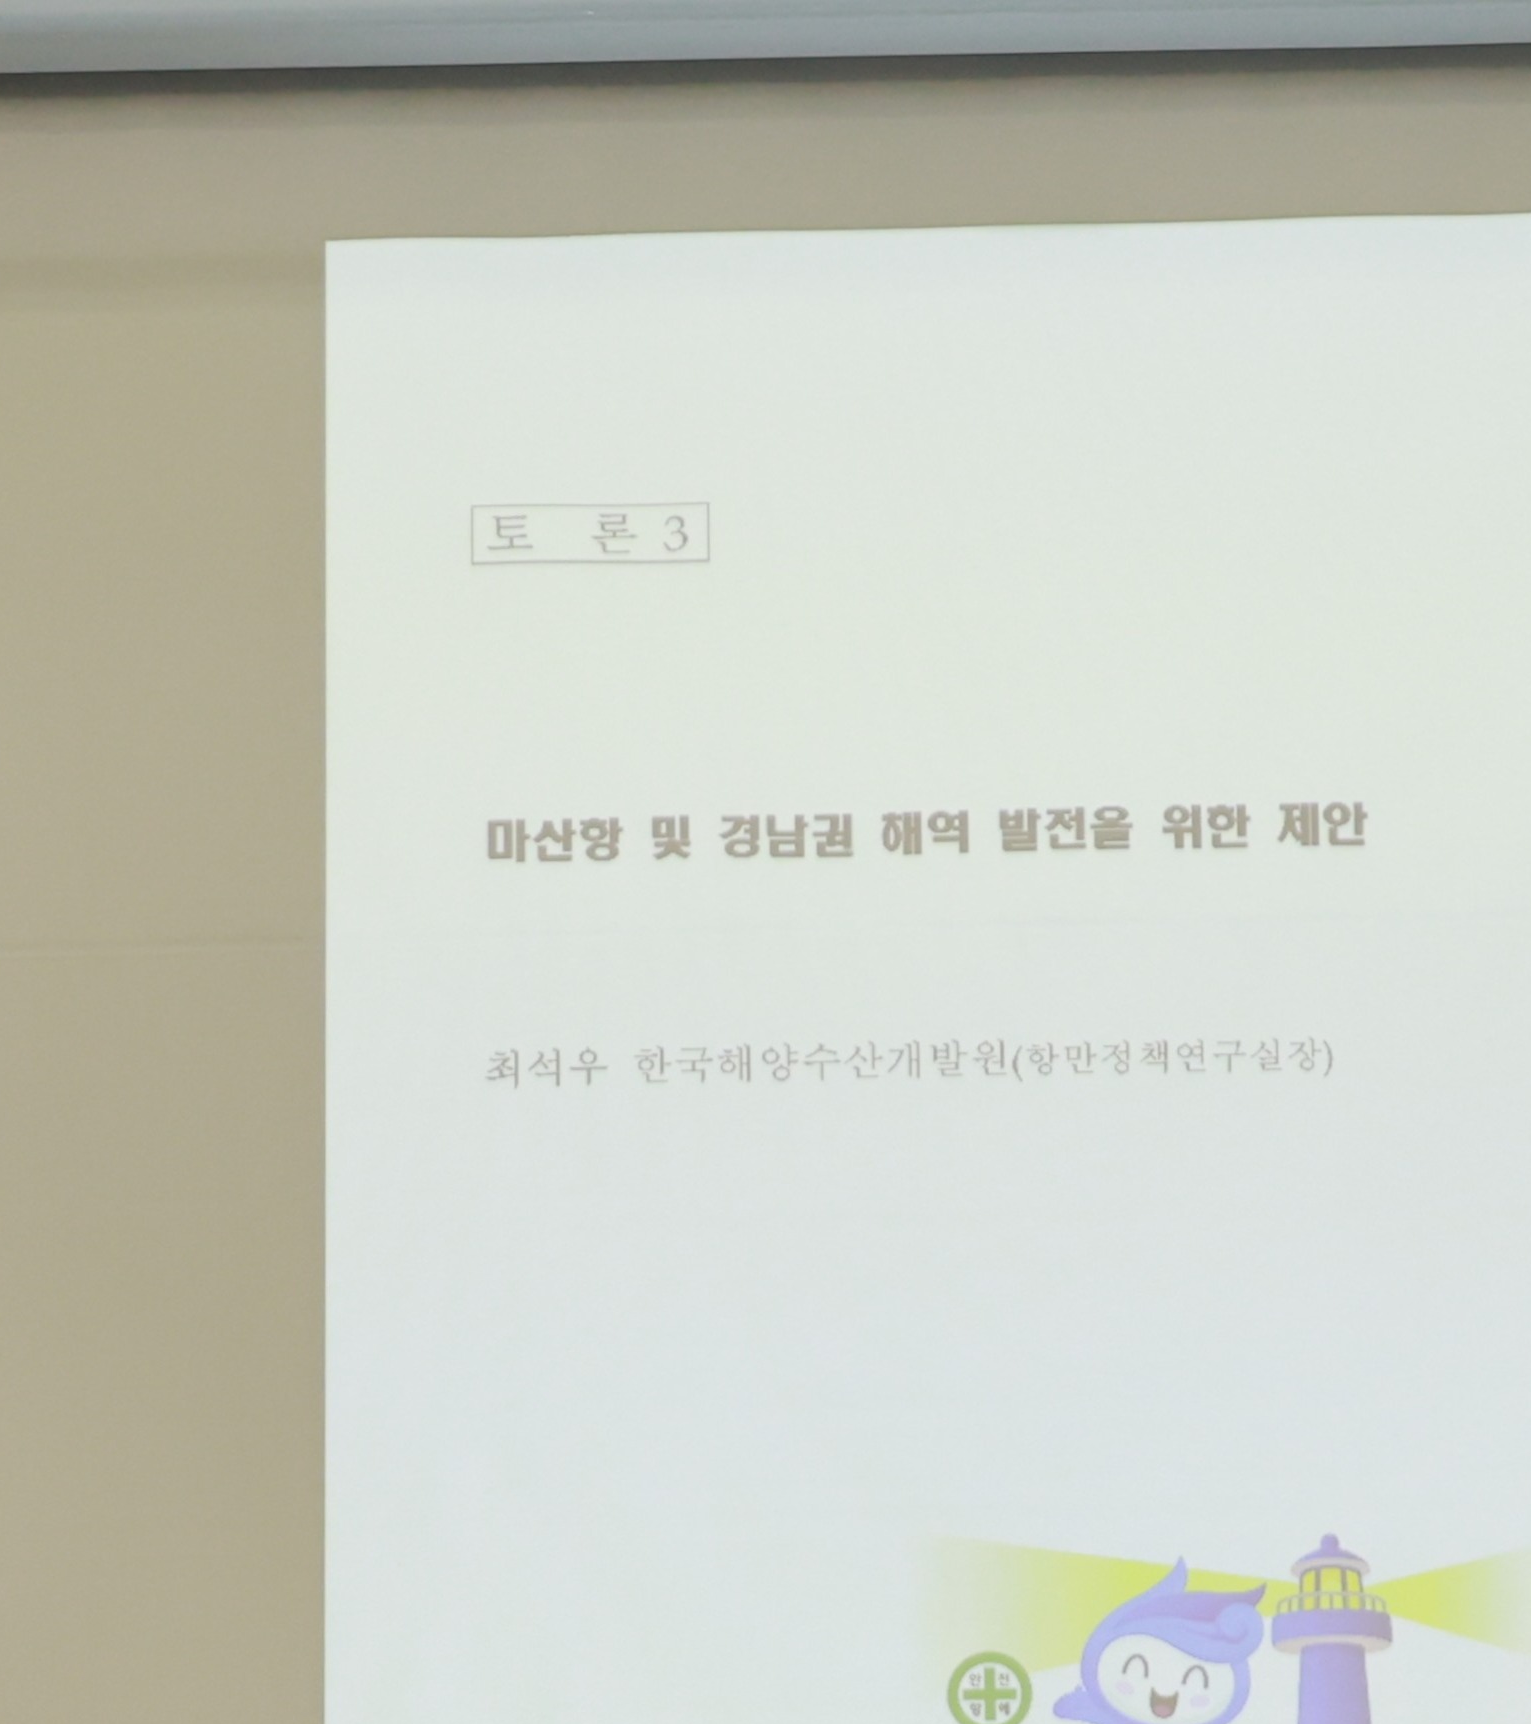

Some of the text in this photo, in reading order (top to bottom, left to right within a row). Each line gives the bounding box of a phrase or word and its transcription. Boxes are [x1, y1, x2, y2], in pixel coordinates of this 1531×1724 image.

[663, 515, 689, 552] 3
[487, 802, 1368, 863] 마산항 및 경남권 해역 발전을 위한 제안
[485, 1047, 608, 1089] 최석우
